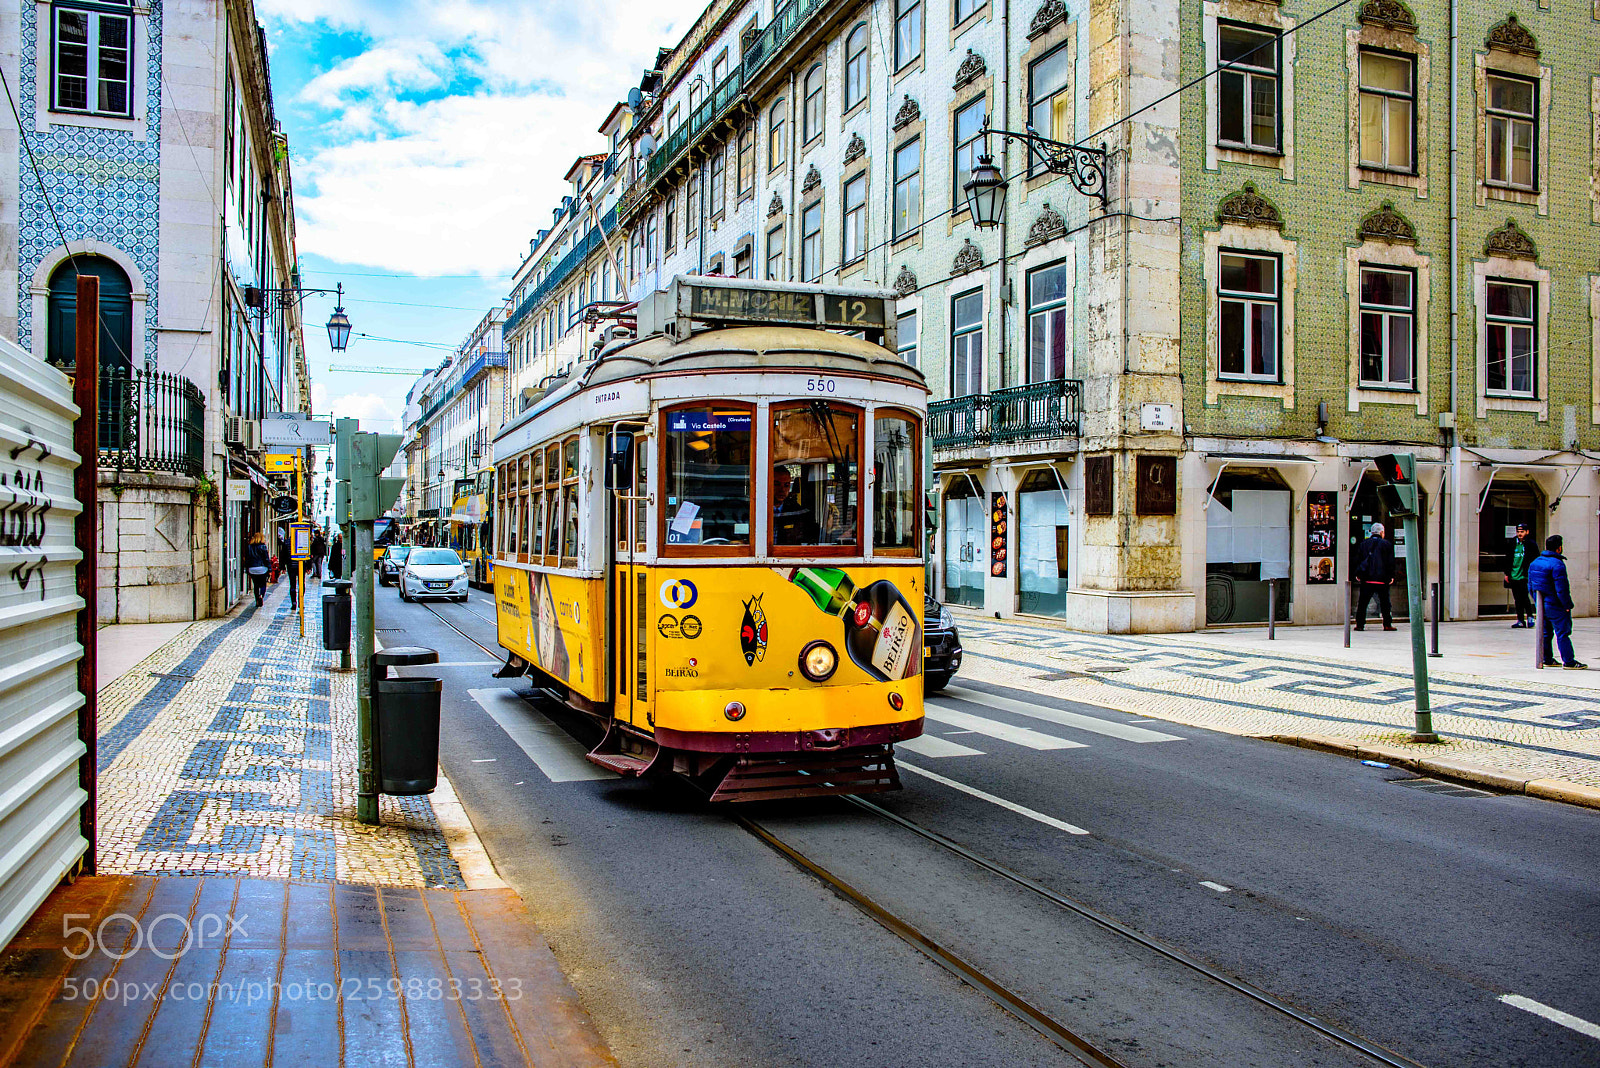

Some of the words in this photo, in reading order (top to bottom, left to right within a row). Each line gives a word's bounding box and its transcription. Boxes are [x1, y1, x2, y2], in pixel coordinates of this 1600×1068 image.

[838, 300, 867, 324] 12
[807, 379, 835, 393] 550
[595, 391, 621, 404] ENTRADA
[1341, 484, 1348, 492] 19
[670, 534, 680, 542] 01
[884, 617, 907, 672] BEIRÃO
[665, 668, 699, 678] BEIRÃO
